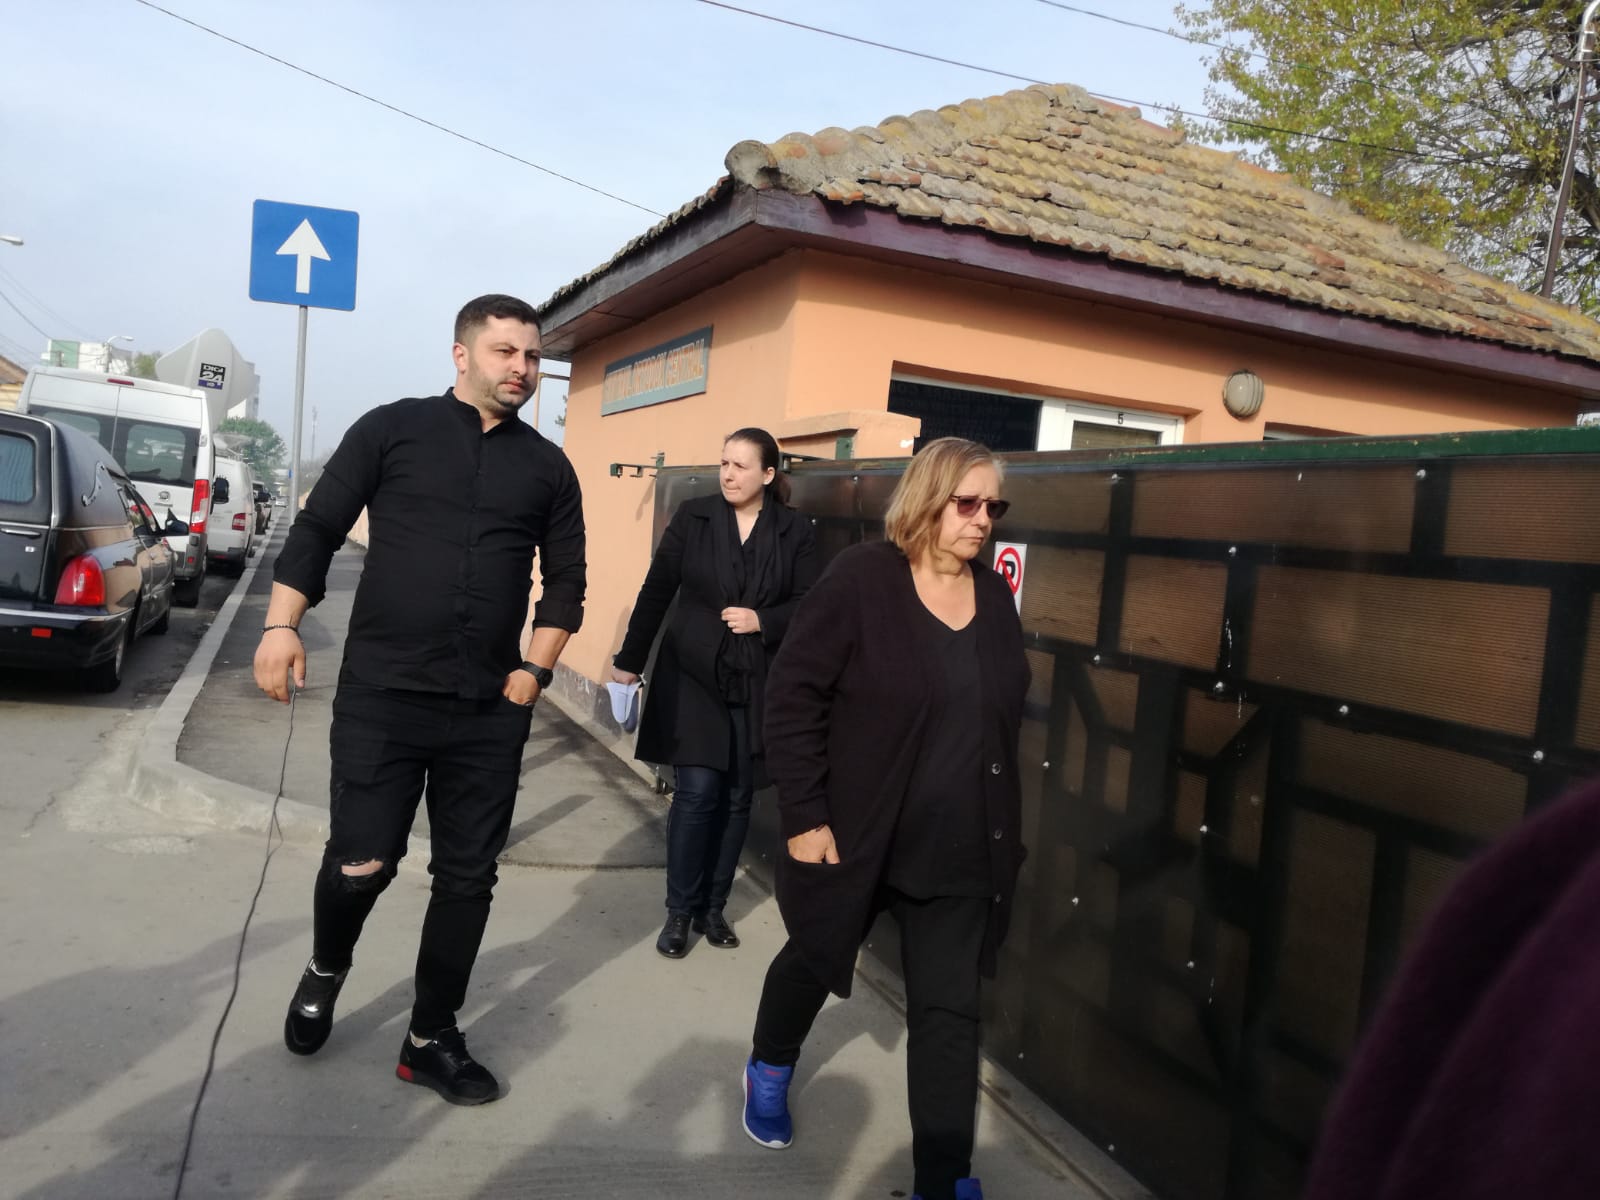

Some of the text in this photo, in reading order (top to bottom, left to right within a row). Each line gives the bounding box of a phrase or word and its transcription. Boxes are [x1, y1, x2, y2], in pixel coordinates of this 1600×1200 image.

[203, 364, 224, 374] DIGI
[200, 370, 225, 385] 24
[1117, 412, 1125, 425] 5
